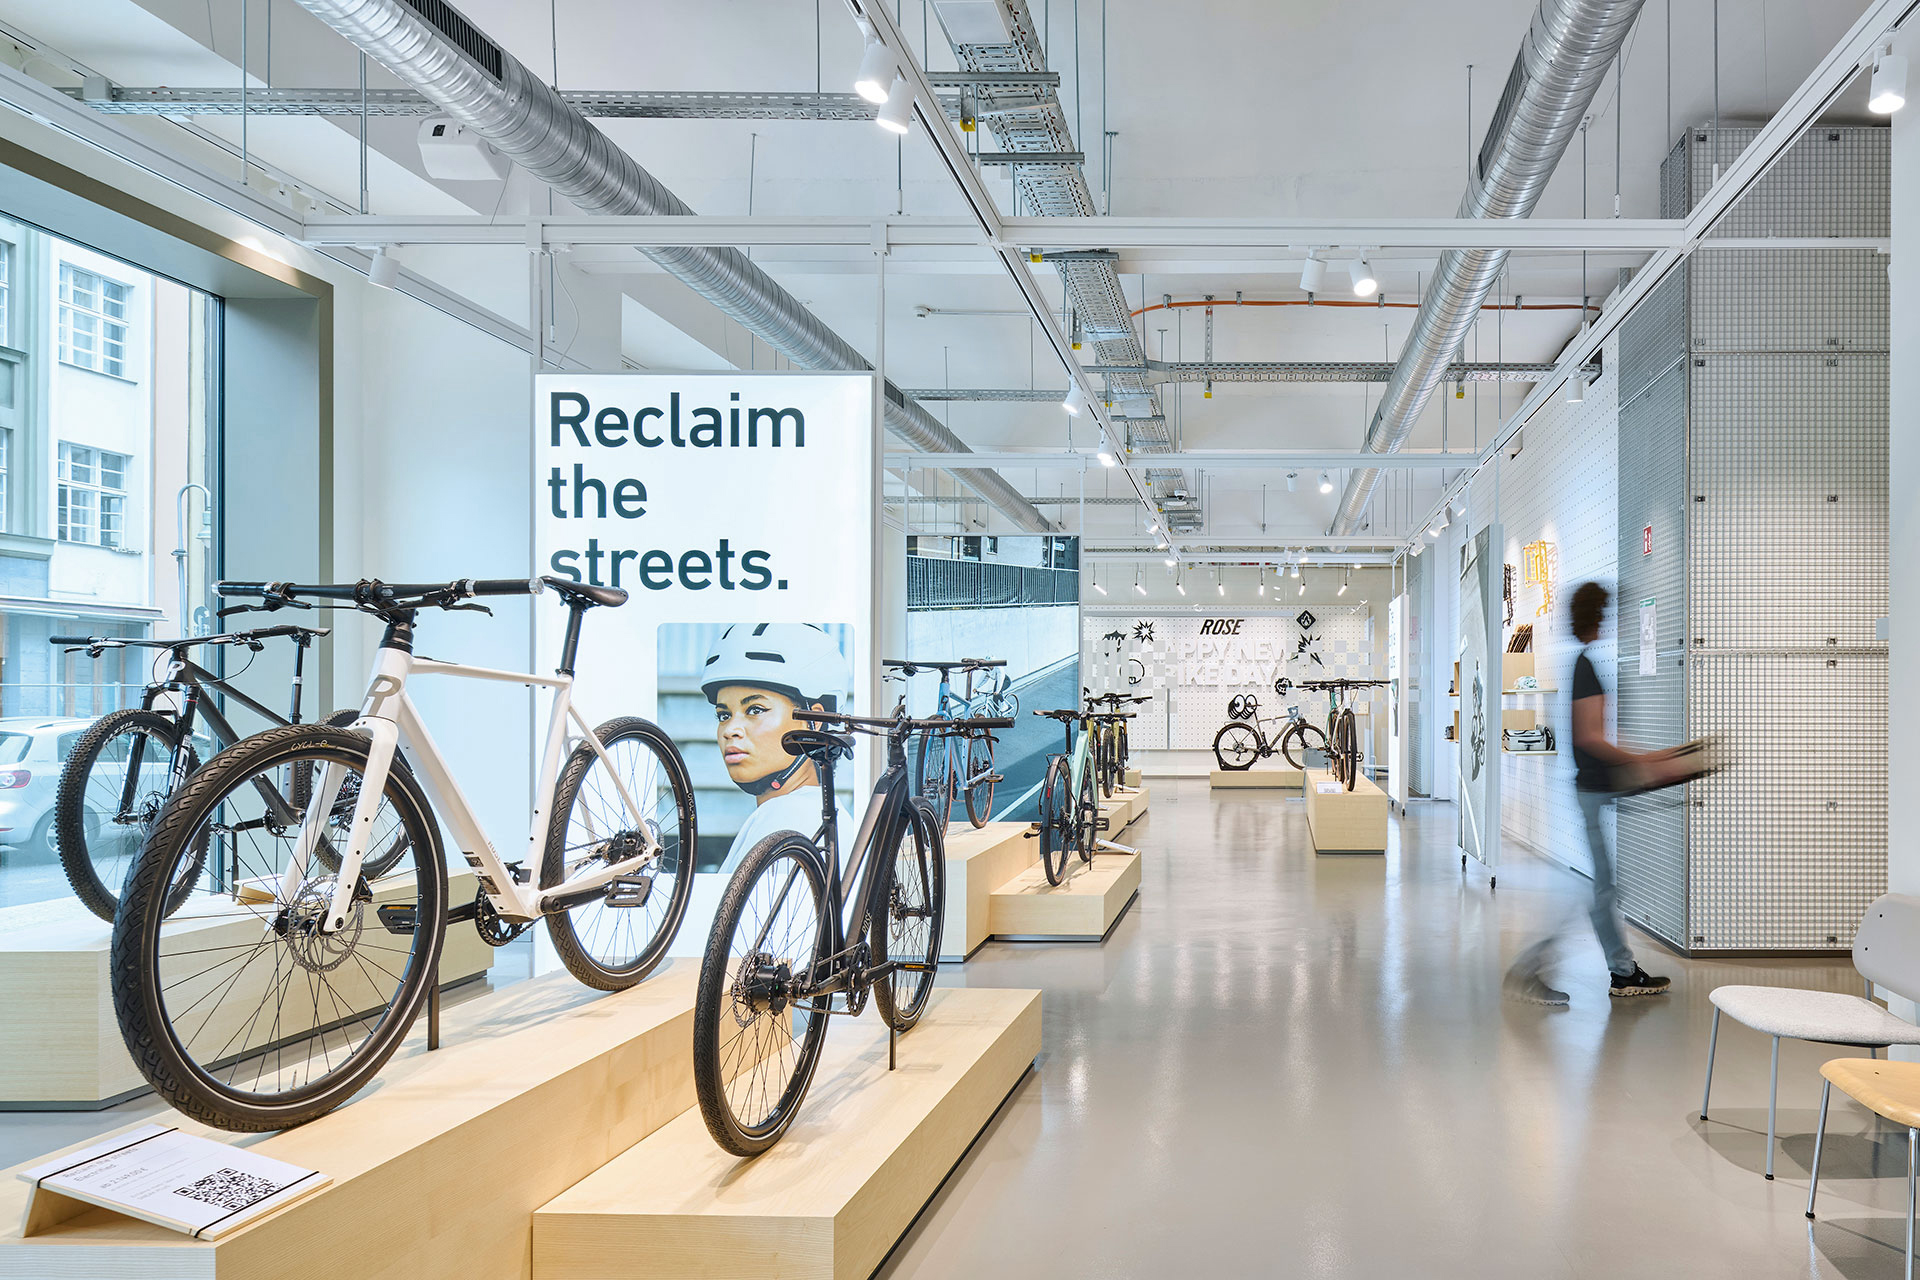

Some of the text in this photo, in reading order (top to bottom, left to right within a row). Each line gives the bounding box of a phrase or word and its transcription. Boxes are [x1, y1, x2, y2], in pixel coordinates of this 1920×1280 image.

[550, 391, 805, 448] Reclaim
[547, 463, 648, 519] the
[550, 538, 788, 590] streets.
[1199, 619, 1245, 635] ROSE
